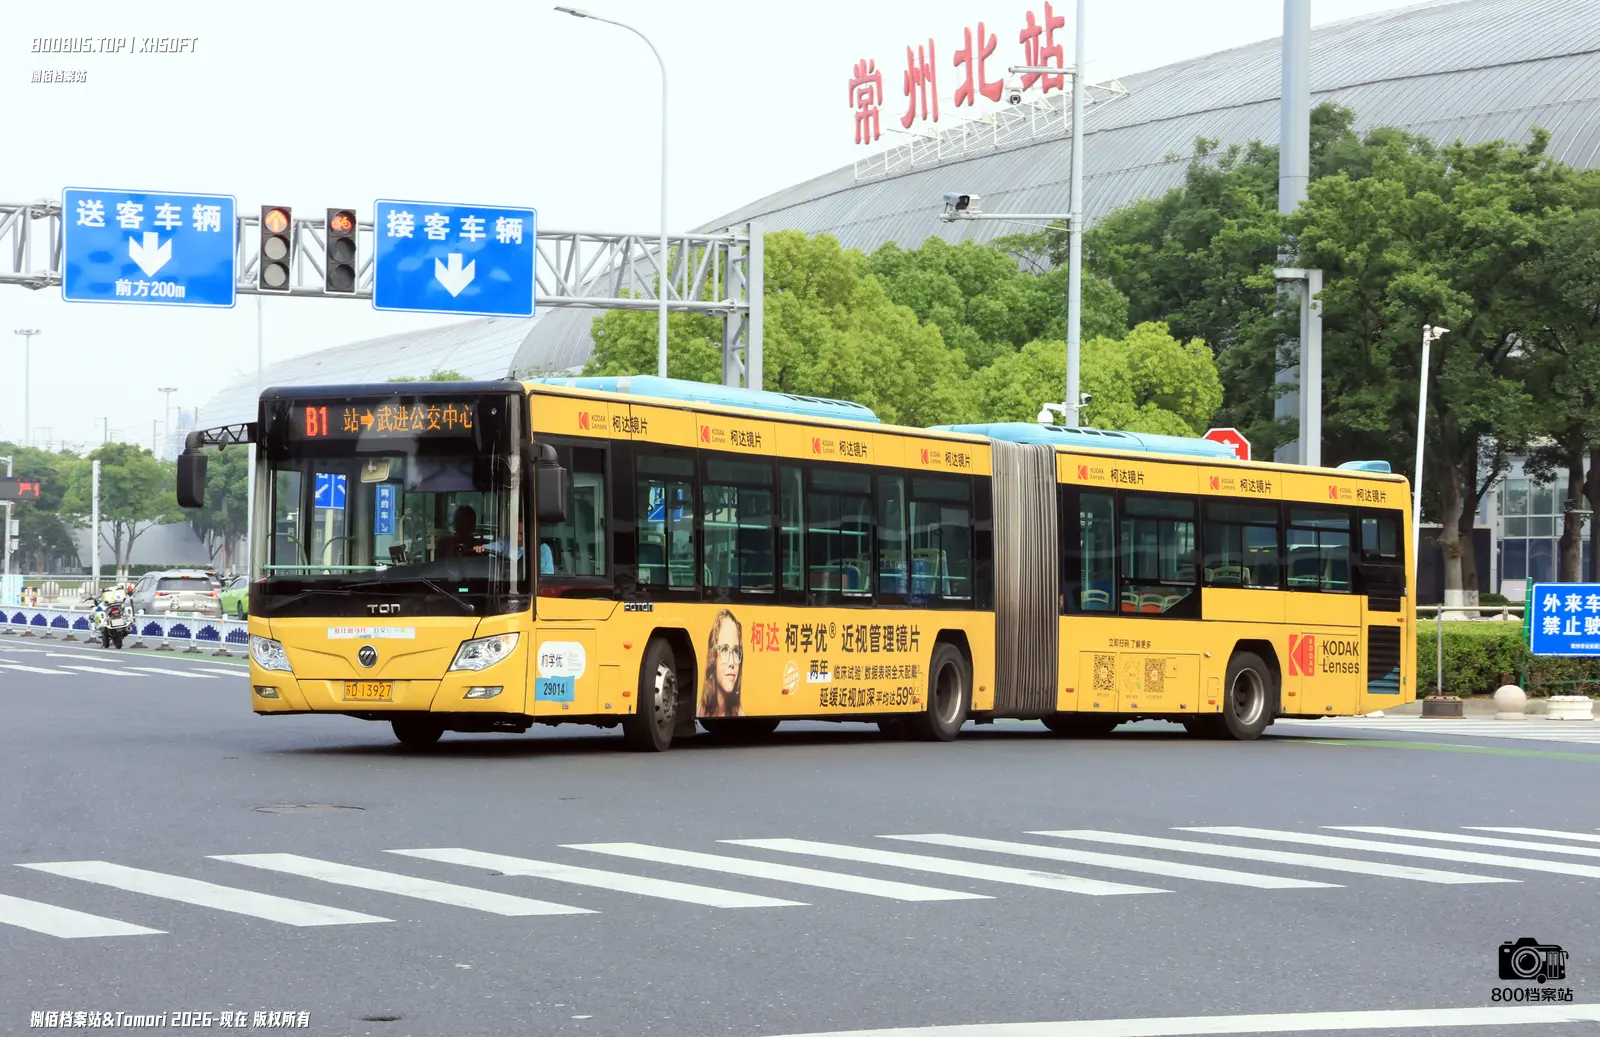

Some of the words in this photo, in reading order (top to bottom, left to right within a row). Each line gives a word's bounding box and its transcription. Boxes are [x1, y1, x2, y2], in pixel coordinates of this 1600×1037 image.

[849, 1, 1066, 144] 常州北站
[76, 199, 222, 232] 送客车辆
[386, 209, 523, 244] 接客车辆
[115, 278, 186, 298] 前方200m
[305, 406, 328, 437] B1
[612, 415, 648, 435] 柯达镜片
[730, 429, 762, 449] 柯达镜片
[839, 440, 868, 459] 柯达镜片
[945, 451, 971, 469] 柯达镜片
[1110, 468, 1144, 485] 柯达镜片
[1240, 478, 1271, 494] 柯达镜片
[1356, 488, 1387, 503] 柯达镜片
[1542, 593, 1600, 613] 外来车
[751, 621, 780, 653] 柯达
[841, 623, 921, 653] 近视管理镜片
[1322, 640, 1360, 656] KODAK
[809, 659, 829, 680] 两年
[1322, 658, 1360, 674] Lenses
[543, 682, 566, 696] 29014
